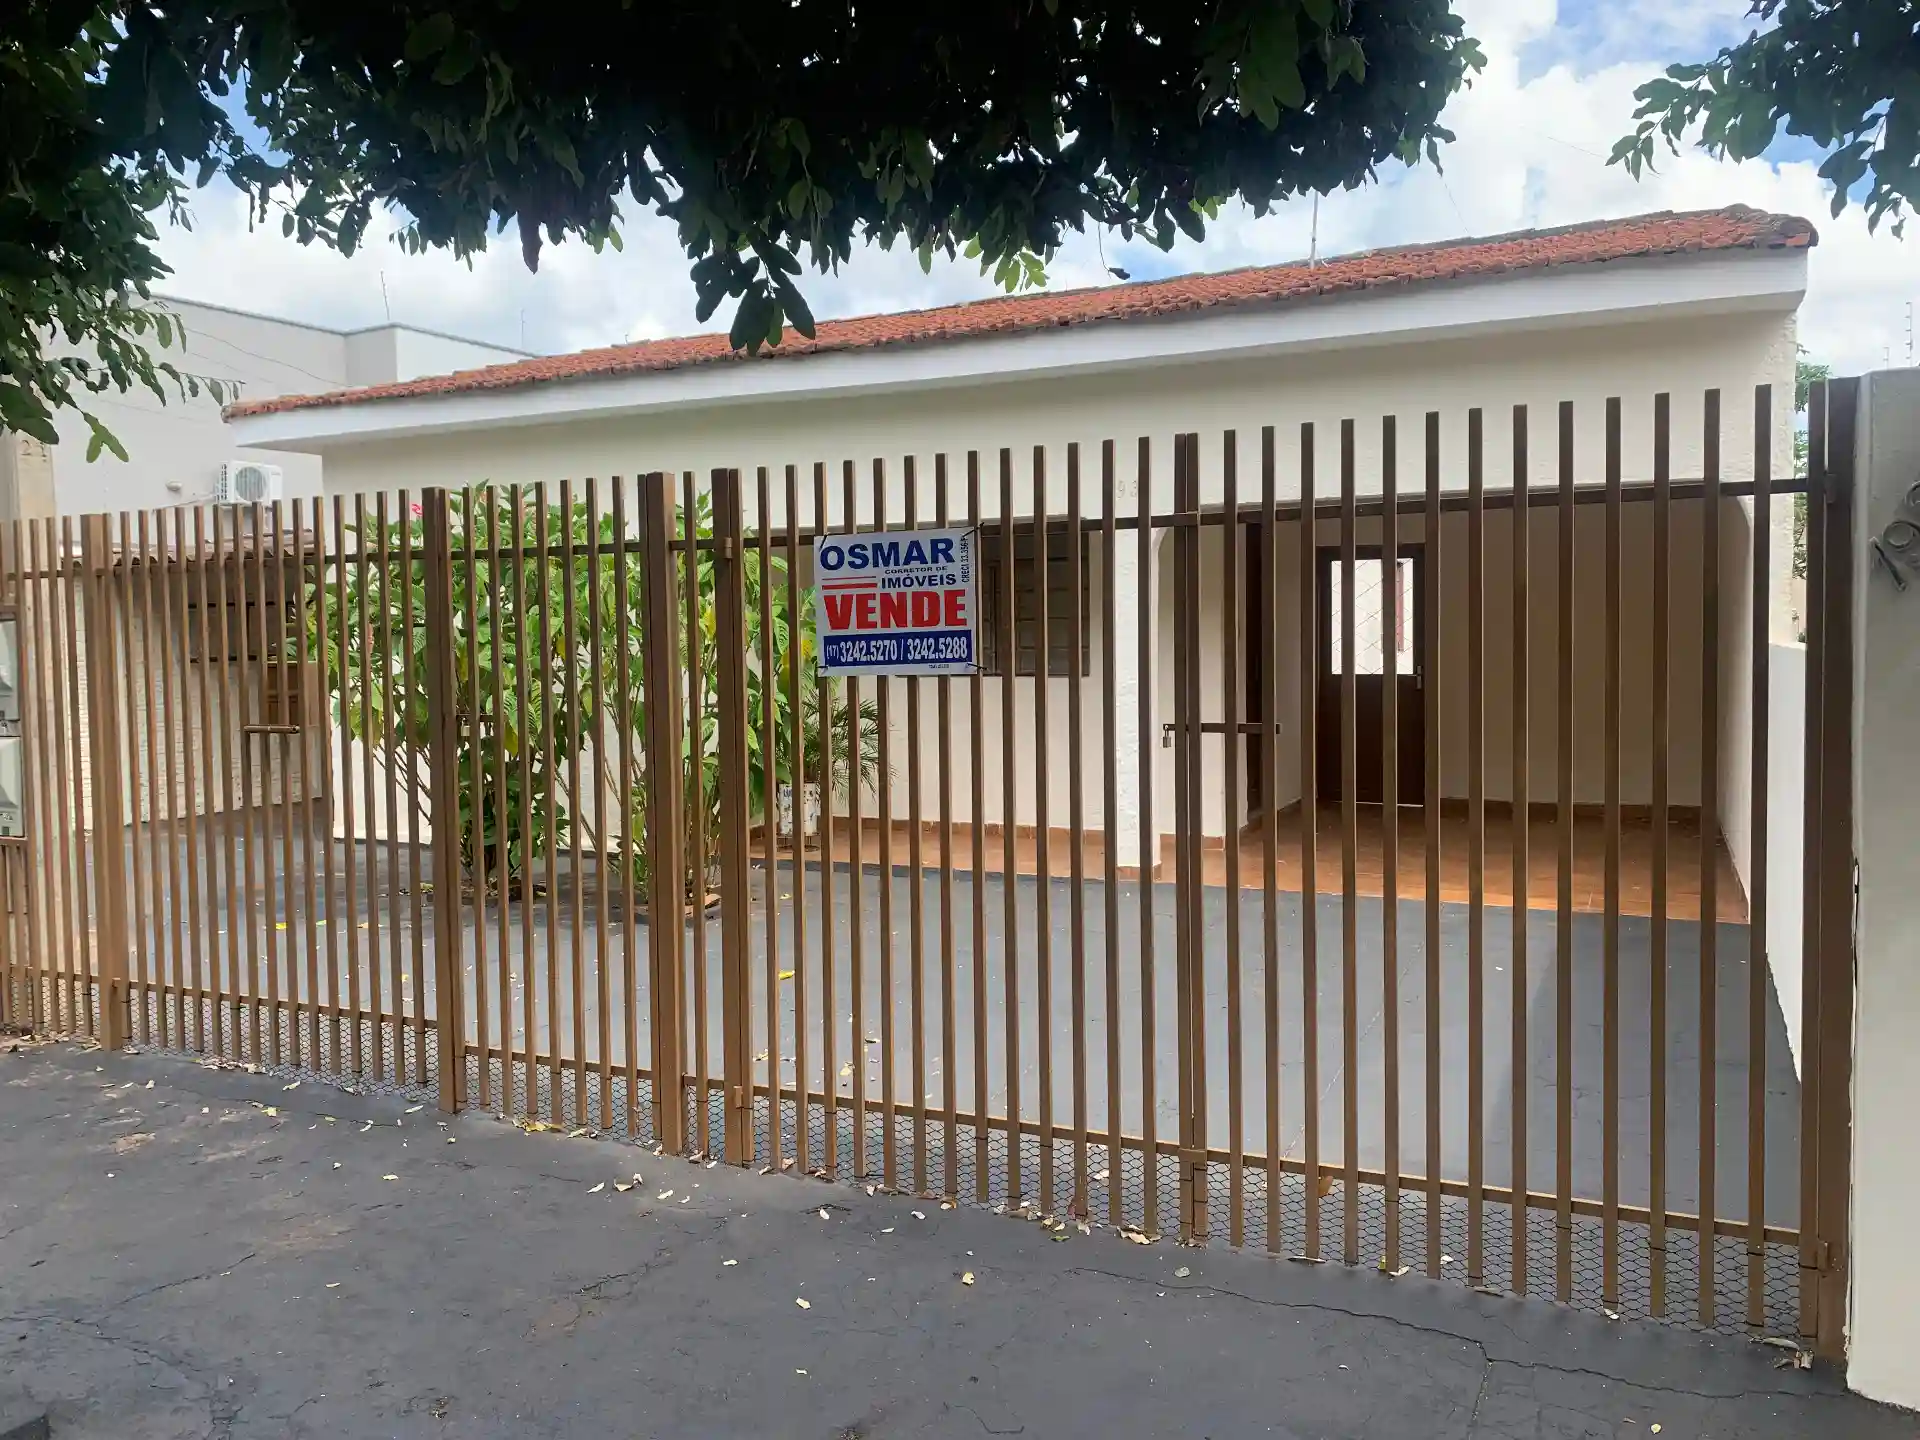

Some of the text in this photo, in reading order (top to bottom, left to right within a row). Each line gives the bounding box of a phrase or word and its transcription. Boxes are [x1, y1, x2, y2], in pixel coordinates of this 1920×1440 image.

[820, 538, 955, 571] OSMAR
[881, 573, 957, 589] IMÓVEIS
[884, 566, 933, 574] CORRETOR
[961, 563, 970, 583] CRECI
[824, 589, 968, 630] VENDE
[840, 639, 898, 663] 3242.5270
[907, 636, 968, 660] 3242.5288
